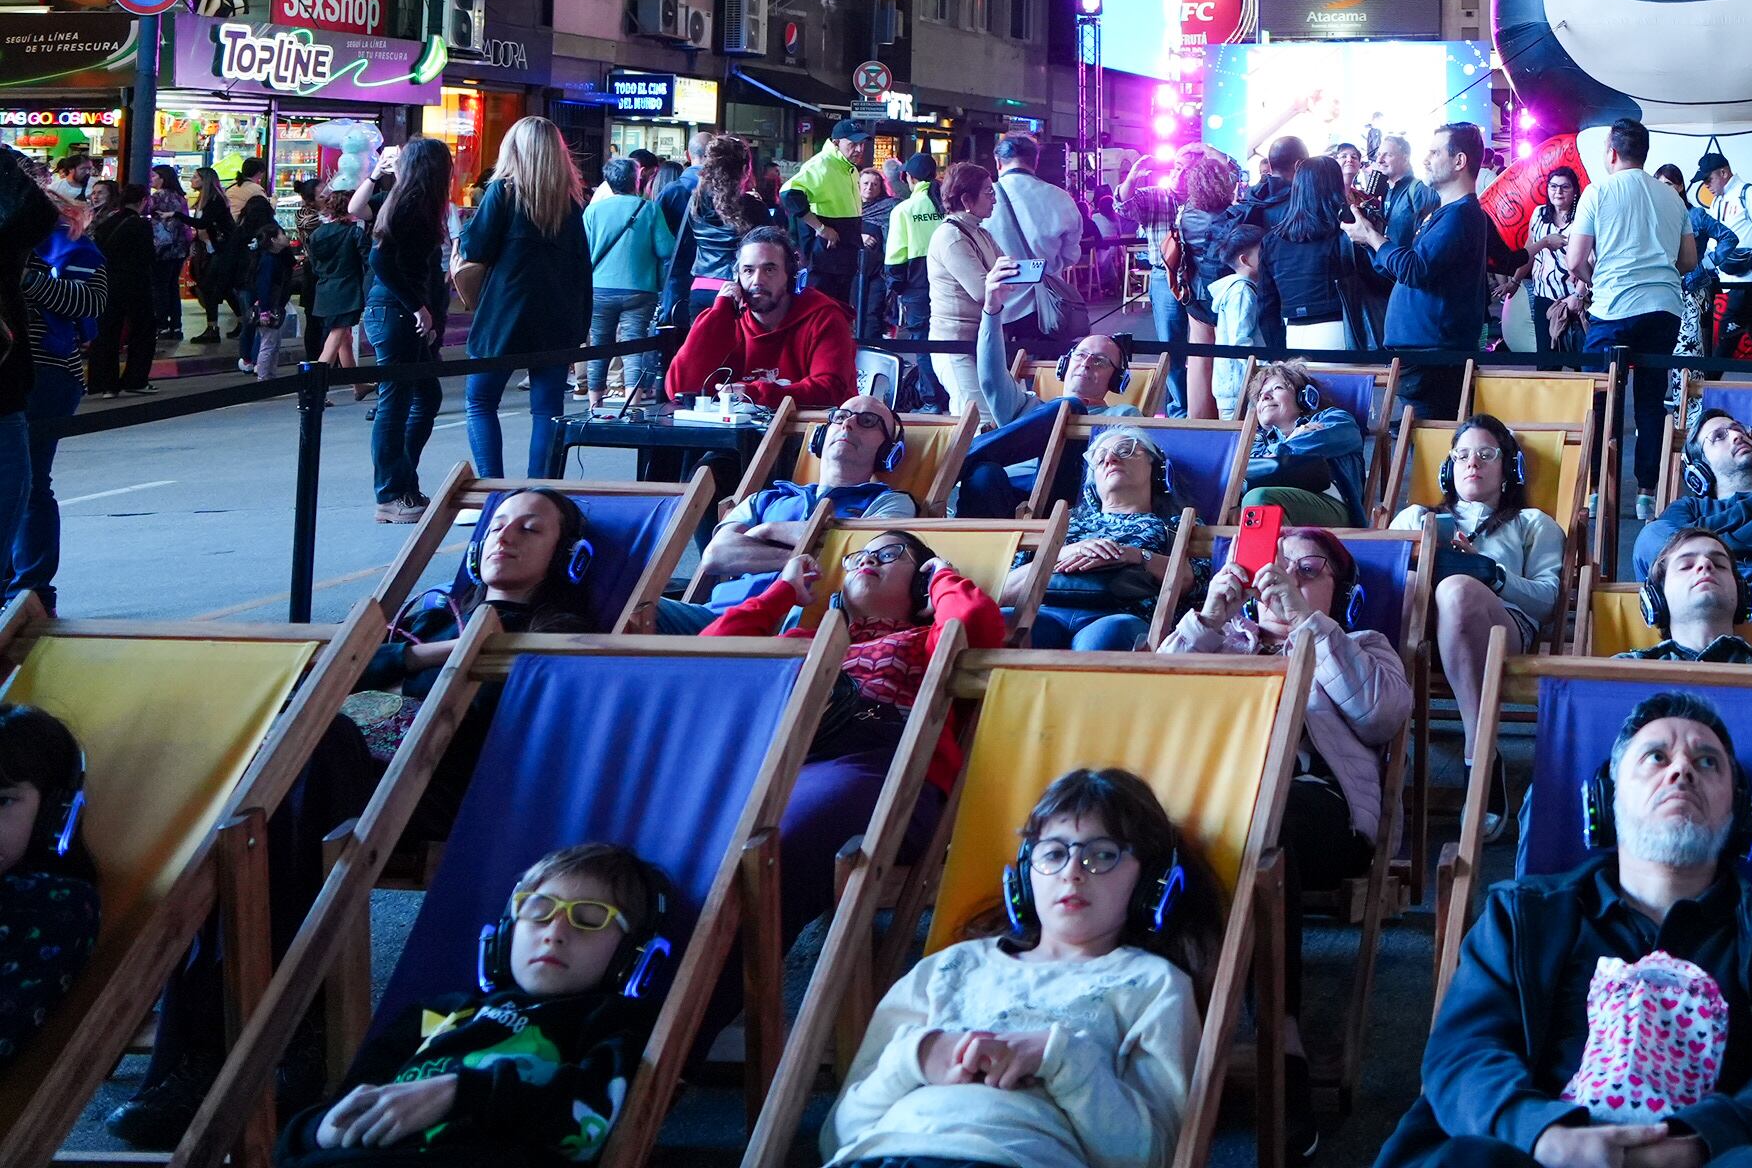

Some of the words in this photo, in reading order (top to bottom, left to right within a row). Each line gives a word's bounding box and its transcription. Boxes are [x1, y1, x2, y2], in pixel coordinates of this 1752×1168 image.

[1181, 1, 1215, 22] FC
[1306, 11, 1367, 23] Atacama
[5, 34, 31, 44] SEGUÍ
[33, 35, 44, 43] LA
[48, 32, 79, 42] LÍNEA
[1181, 32, 1207, 45] FRUTÁ
[25, 45, 37, 53] DE
[41, 44, 53, 52] TU
[56, 42, 119, 52] FRESCURA
[374, 52, 408, 61] FRESCURA
[614, 82, 637, 95] TODO
[638, 83, 647, 95] EL
[648, 82, 667, 95] CINE
[618, 97, 633, 110] DEL
[634, 97, 663, 110] MUNDO
[28, 110, 115, 125] GOLOSINAS
[912, 213, 946, 222] PREVEN
